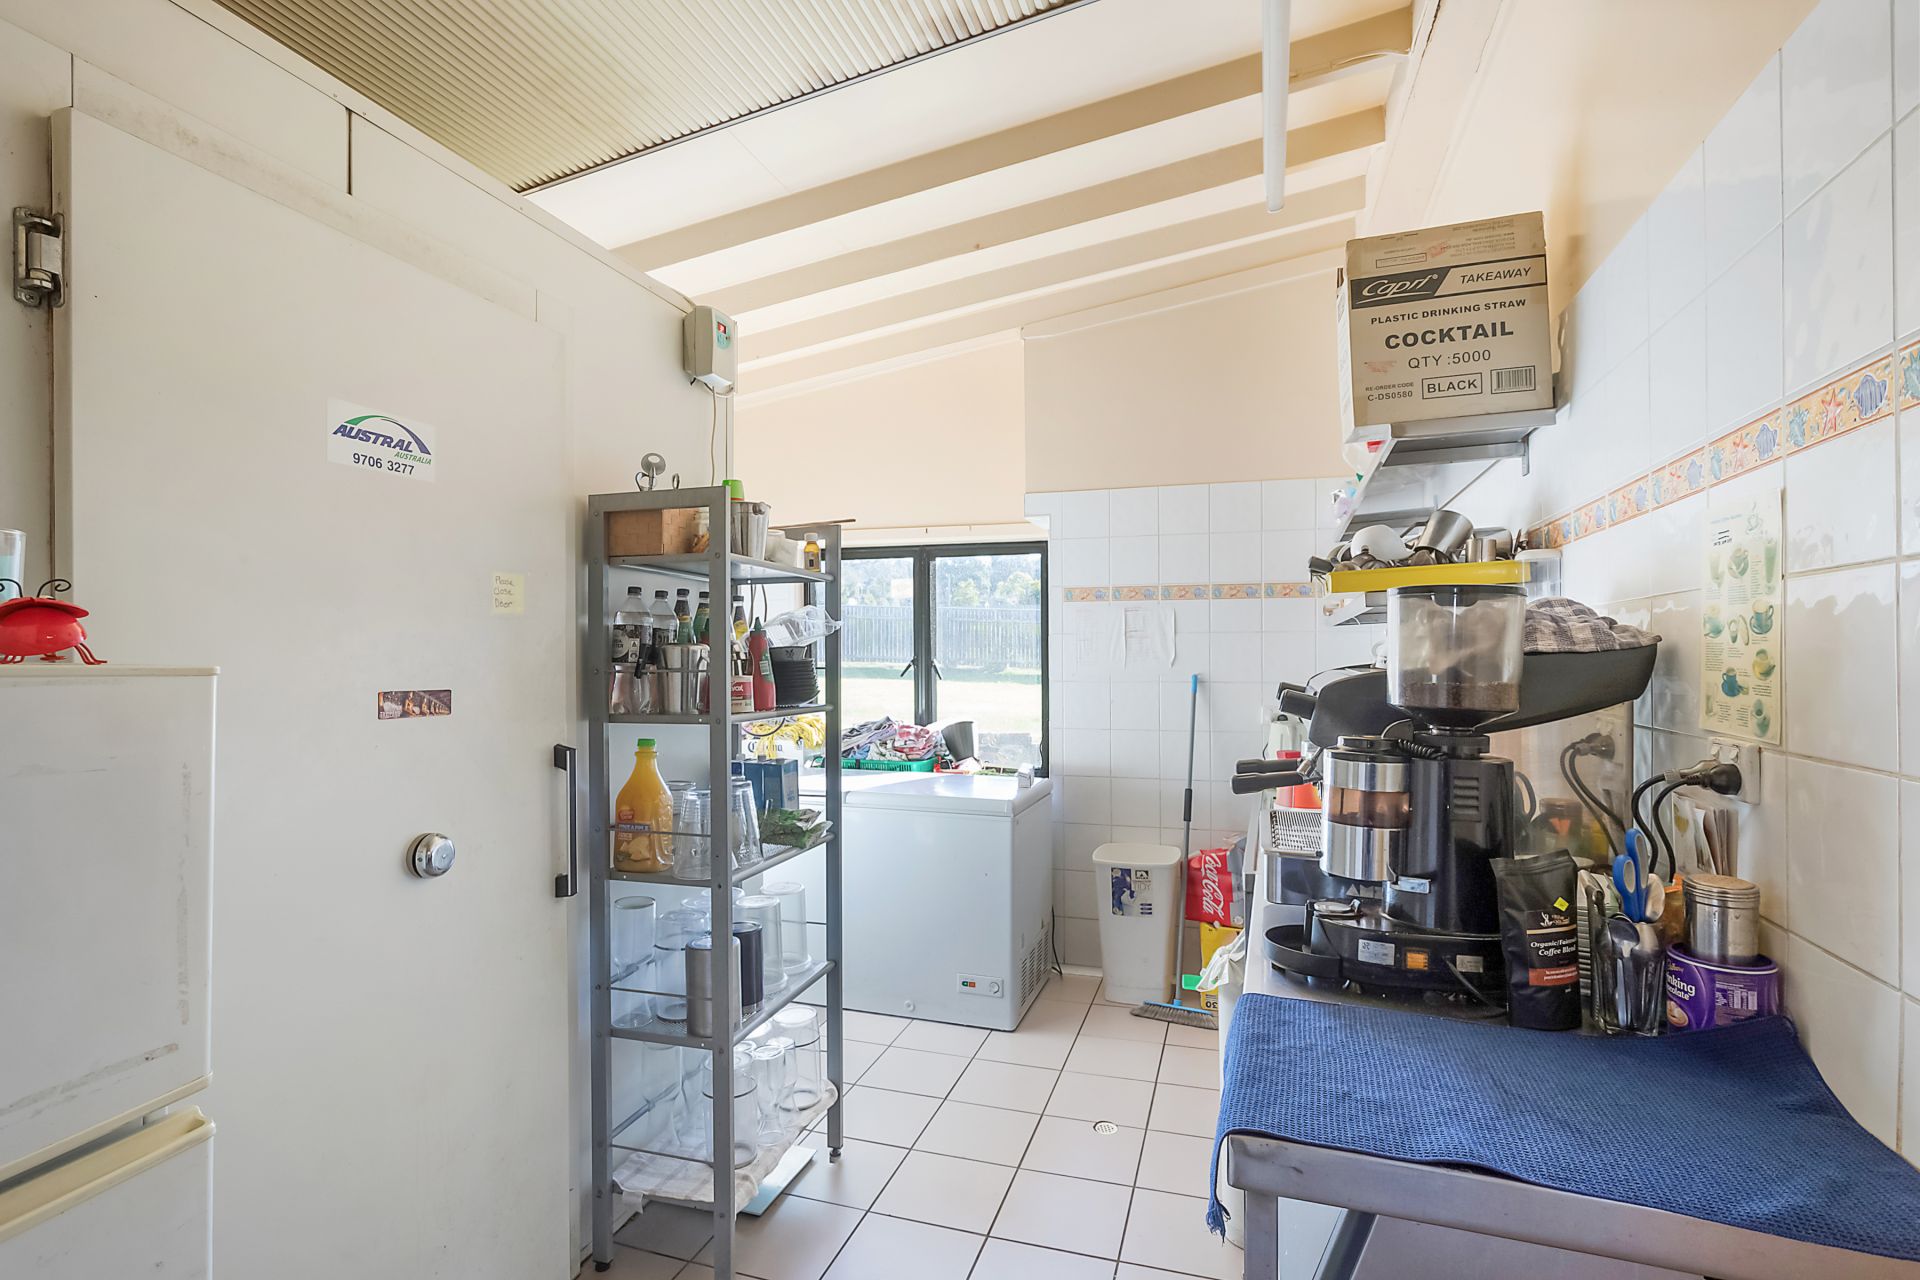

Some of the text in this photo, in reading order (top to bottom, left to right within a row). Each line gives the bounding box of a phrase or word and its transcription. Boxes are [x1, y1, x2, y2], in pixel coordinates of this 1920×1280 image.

[1362, 266, 1532, 297] Capri TAKEAWAY
[1370, 298, 1527, 326] PLASTIC DRINKING STRAW
[1384, 320, 1514, 350] COCKTAIL
[1408, 354, 1443, 370] QTY
[1367, 389, 1413, 402] C-DS0580
[1426, 378, 1478, 394] BLACK
[332, 423, 414, 453] AUSTRAL
[352, 452, 415, 476] 9706 3277
[394, 450, 433, 466] AUSTRALIA
[1538, 948, 1562, 957] Coffee
